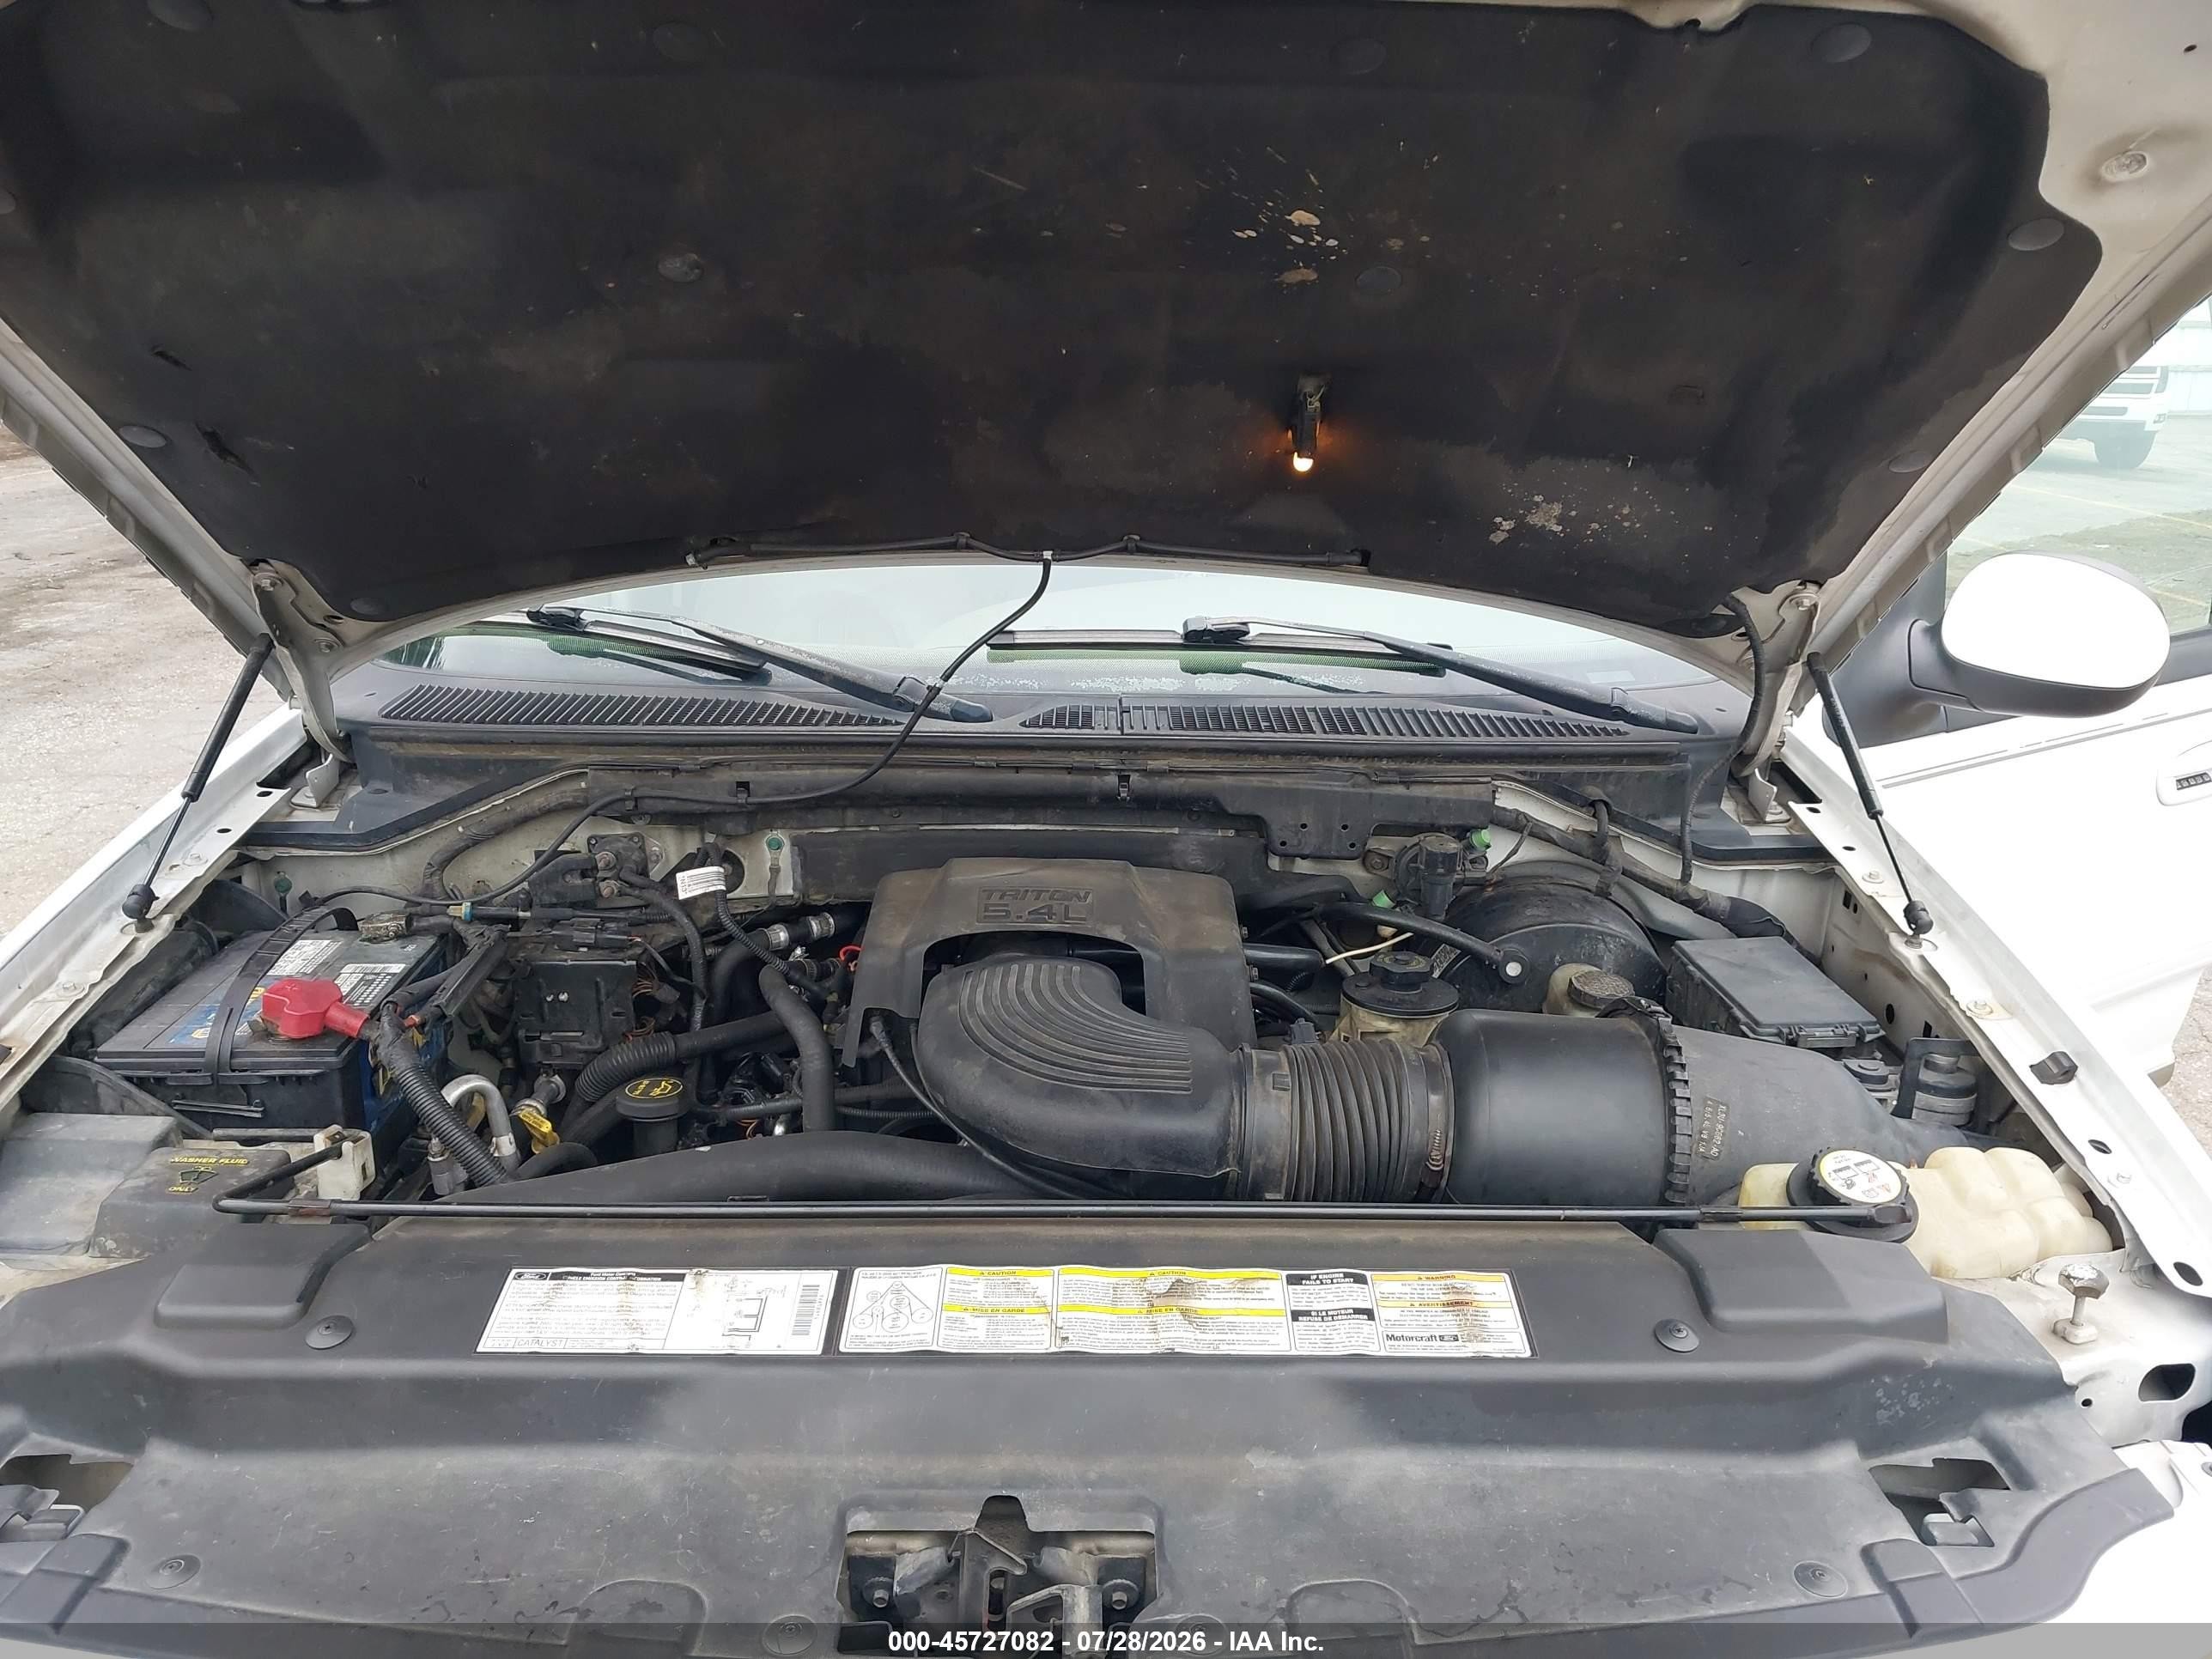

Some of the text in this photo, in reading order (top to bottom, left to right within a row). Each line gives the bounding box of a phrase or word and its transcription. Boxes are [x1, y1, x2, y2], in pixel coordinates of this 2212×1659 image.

[981, 888, 1091, 902] TRITON
[981, 902, 1086, 921] 5.4L
[517, 1339, 563, 1347] CATALYST
[1385, 1333, 1438, 1343] Motorcraft
